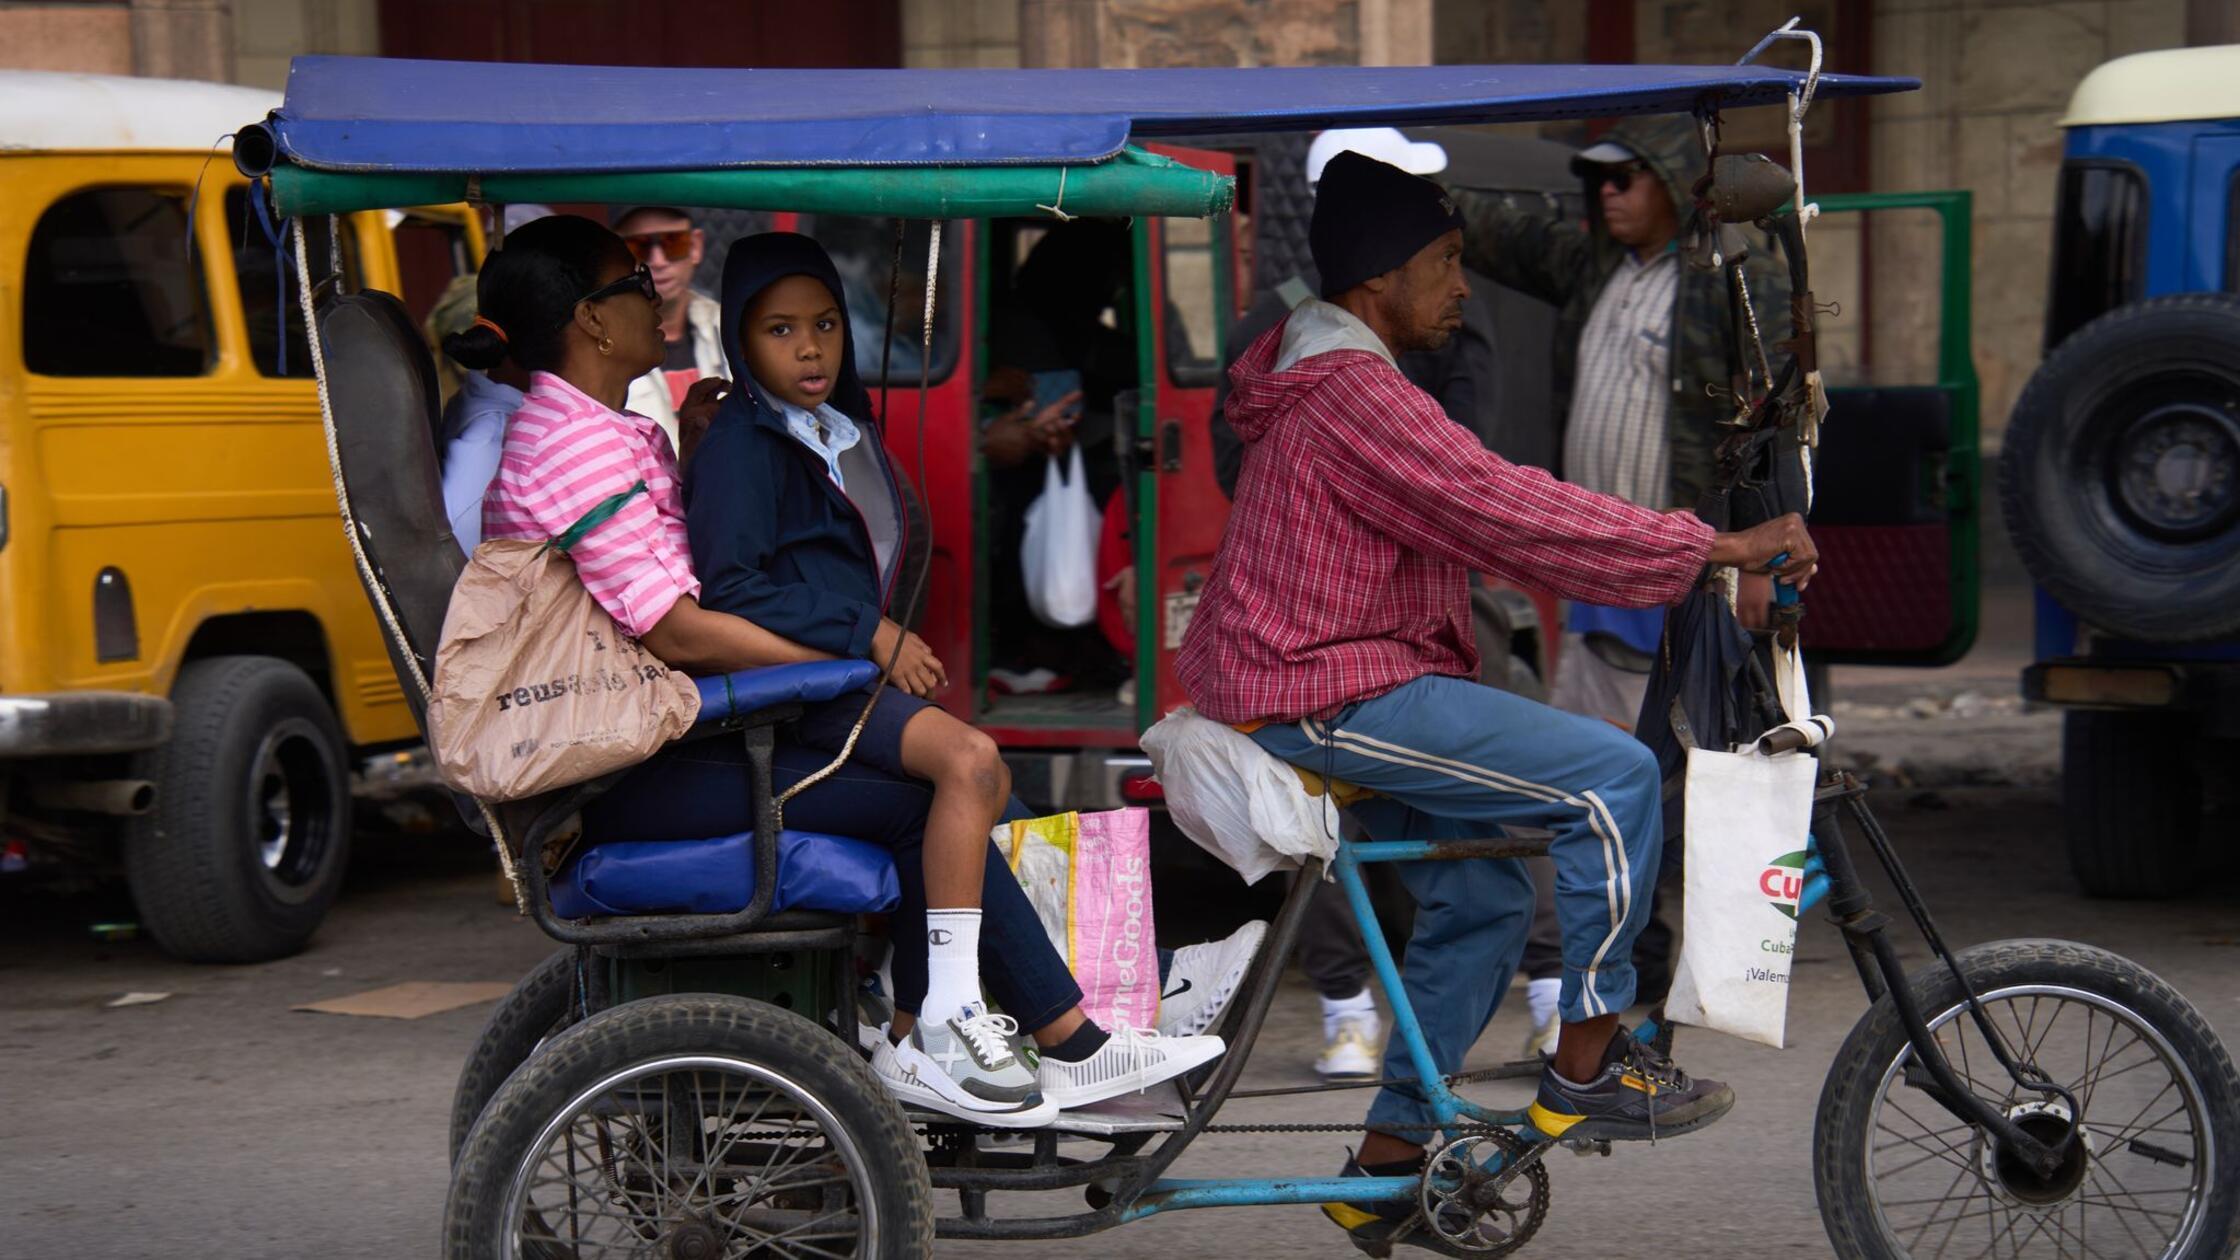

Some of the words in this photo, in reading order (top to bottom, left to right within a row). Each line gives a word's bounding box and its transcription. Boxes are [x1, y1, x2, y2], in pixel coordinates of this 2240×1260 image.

[1760, 867, 1802, 900] Cu
[1111, 856, 1144, 1037] meGoods
[1761, 939, 1796, 955] Cuba
